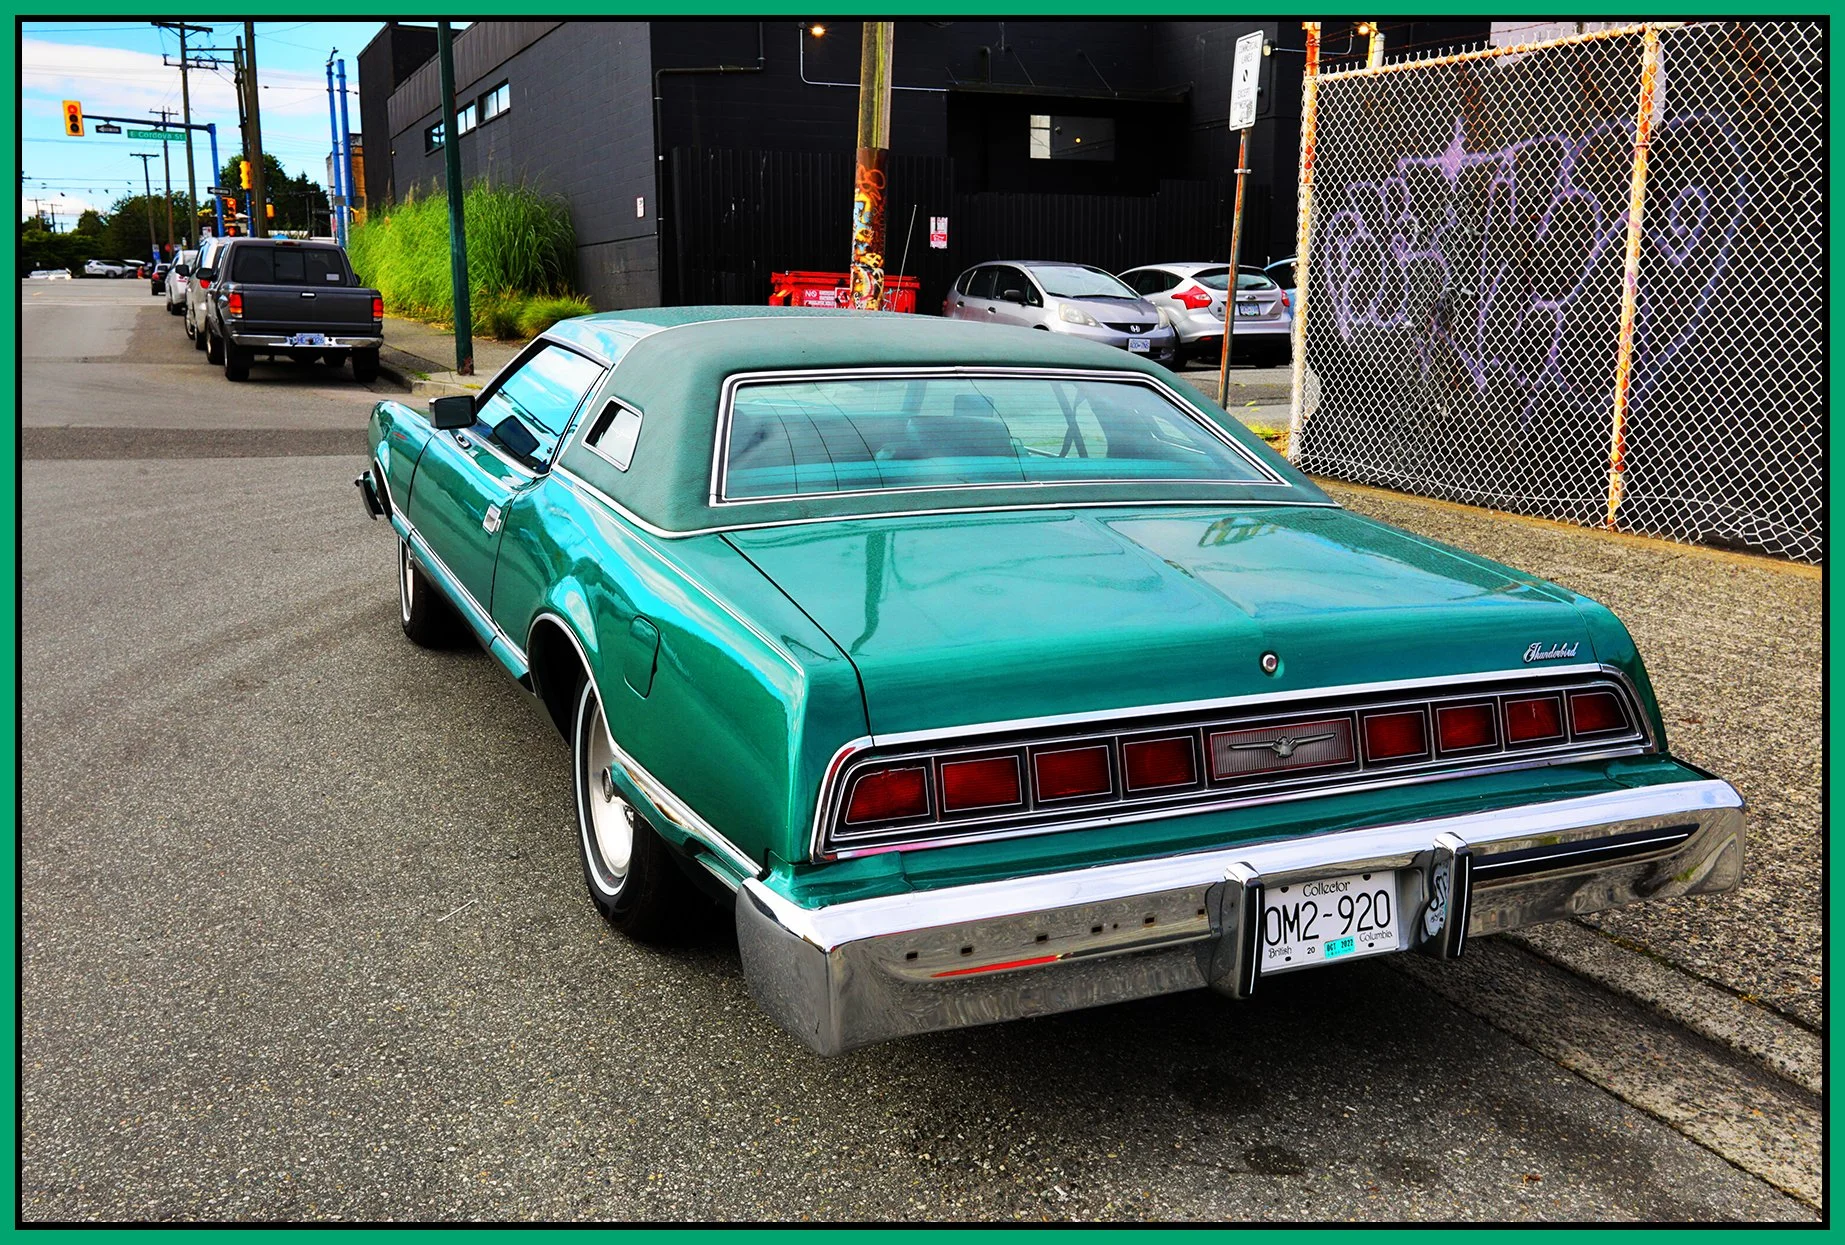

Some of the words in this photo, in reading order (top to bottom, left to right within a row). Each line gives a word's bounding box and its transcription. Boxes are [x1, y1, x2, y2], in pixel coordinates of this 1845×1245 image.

[139, 131, 172, 139] Cordova
[1523, 642, 1579, 662] Thunderbird
[1303, 881, 1350, 897] Collector
[1264, 889, 1391, 946] OM2-920
[1359, 930, 1393, 943] Columbia
[1307, 946, 1316, 954] 20
[1326, 942, 1336, 952] OCT
[1340, 938, 1354, 949] 2022
[1268, 946, 1292, 959] British
